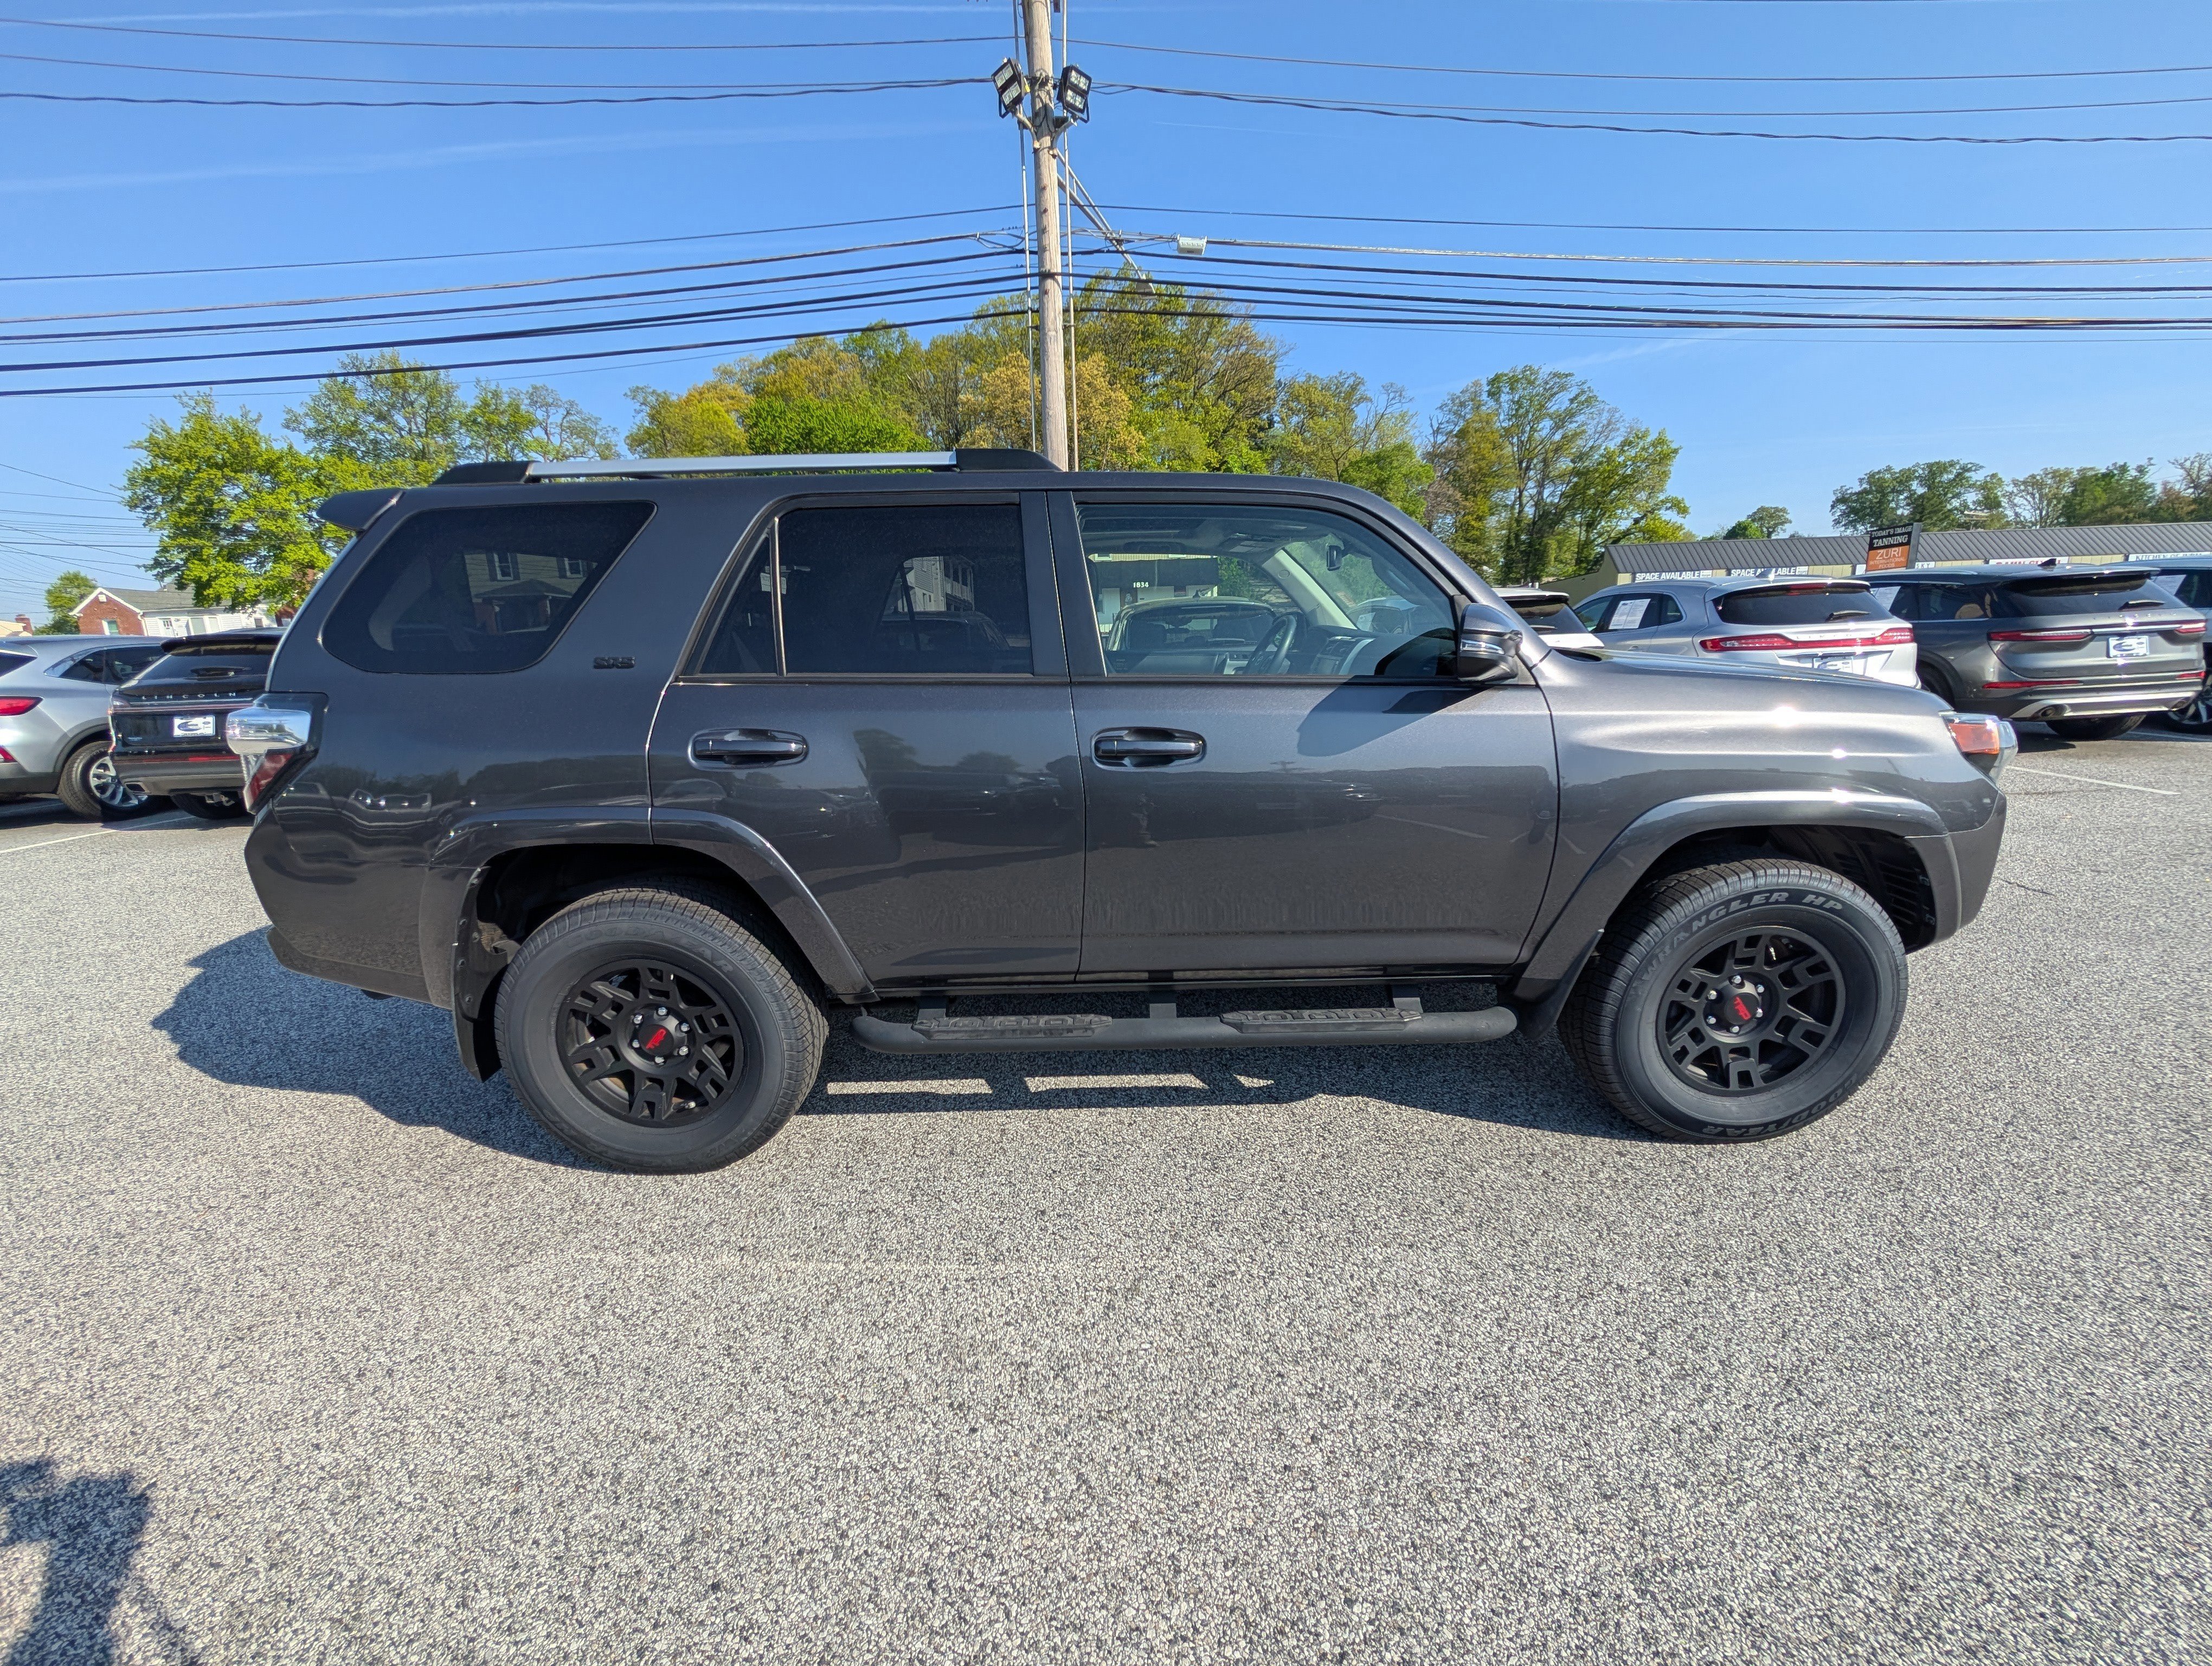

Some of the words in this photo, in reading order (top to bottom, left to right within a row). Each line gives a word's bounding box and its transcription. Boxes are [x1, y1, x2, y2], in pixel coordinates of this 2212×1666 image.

[1873, 535, 1908, 547] TANNING
[1876, 547, 1901, 560] ZURI
[1660, 571, 1700, 580] AVAILABLE
[1802, 894, 1842, 911] HP
